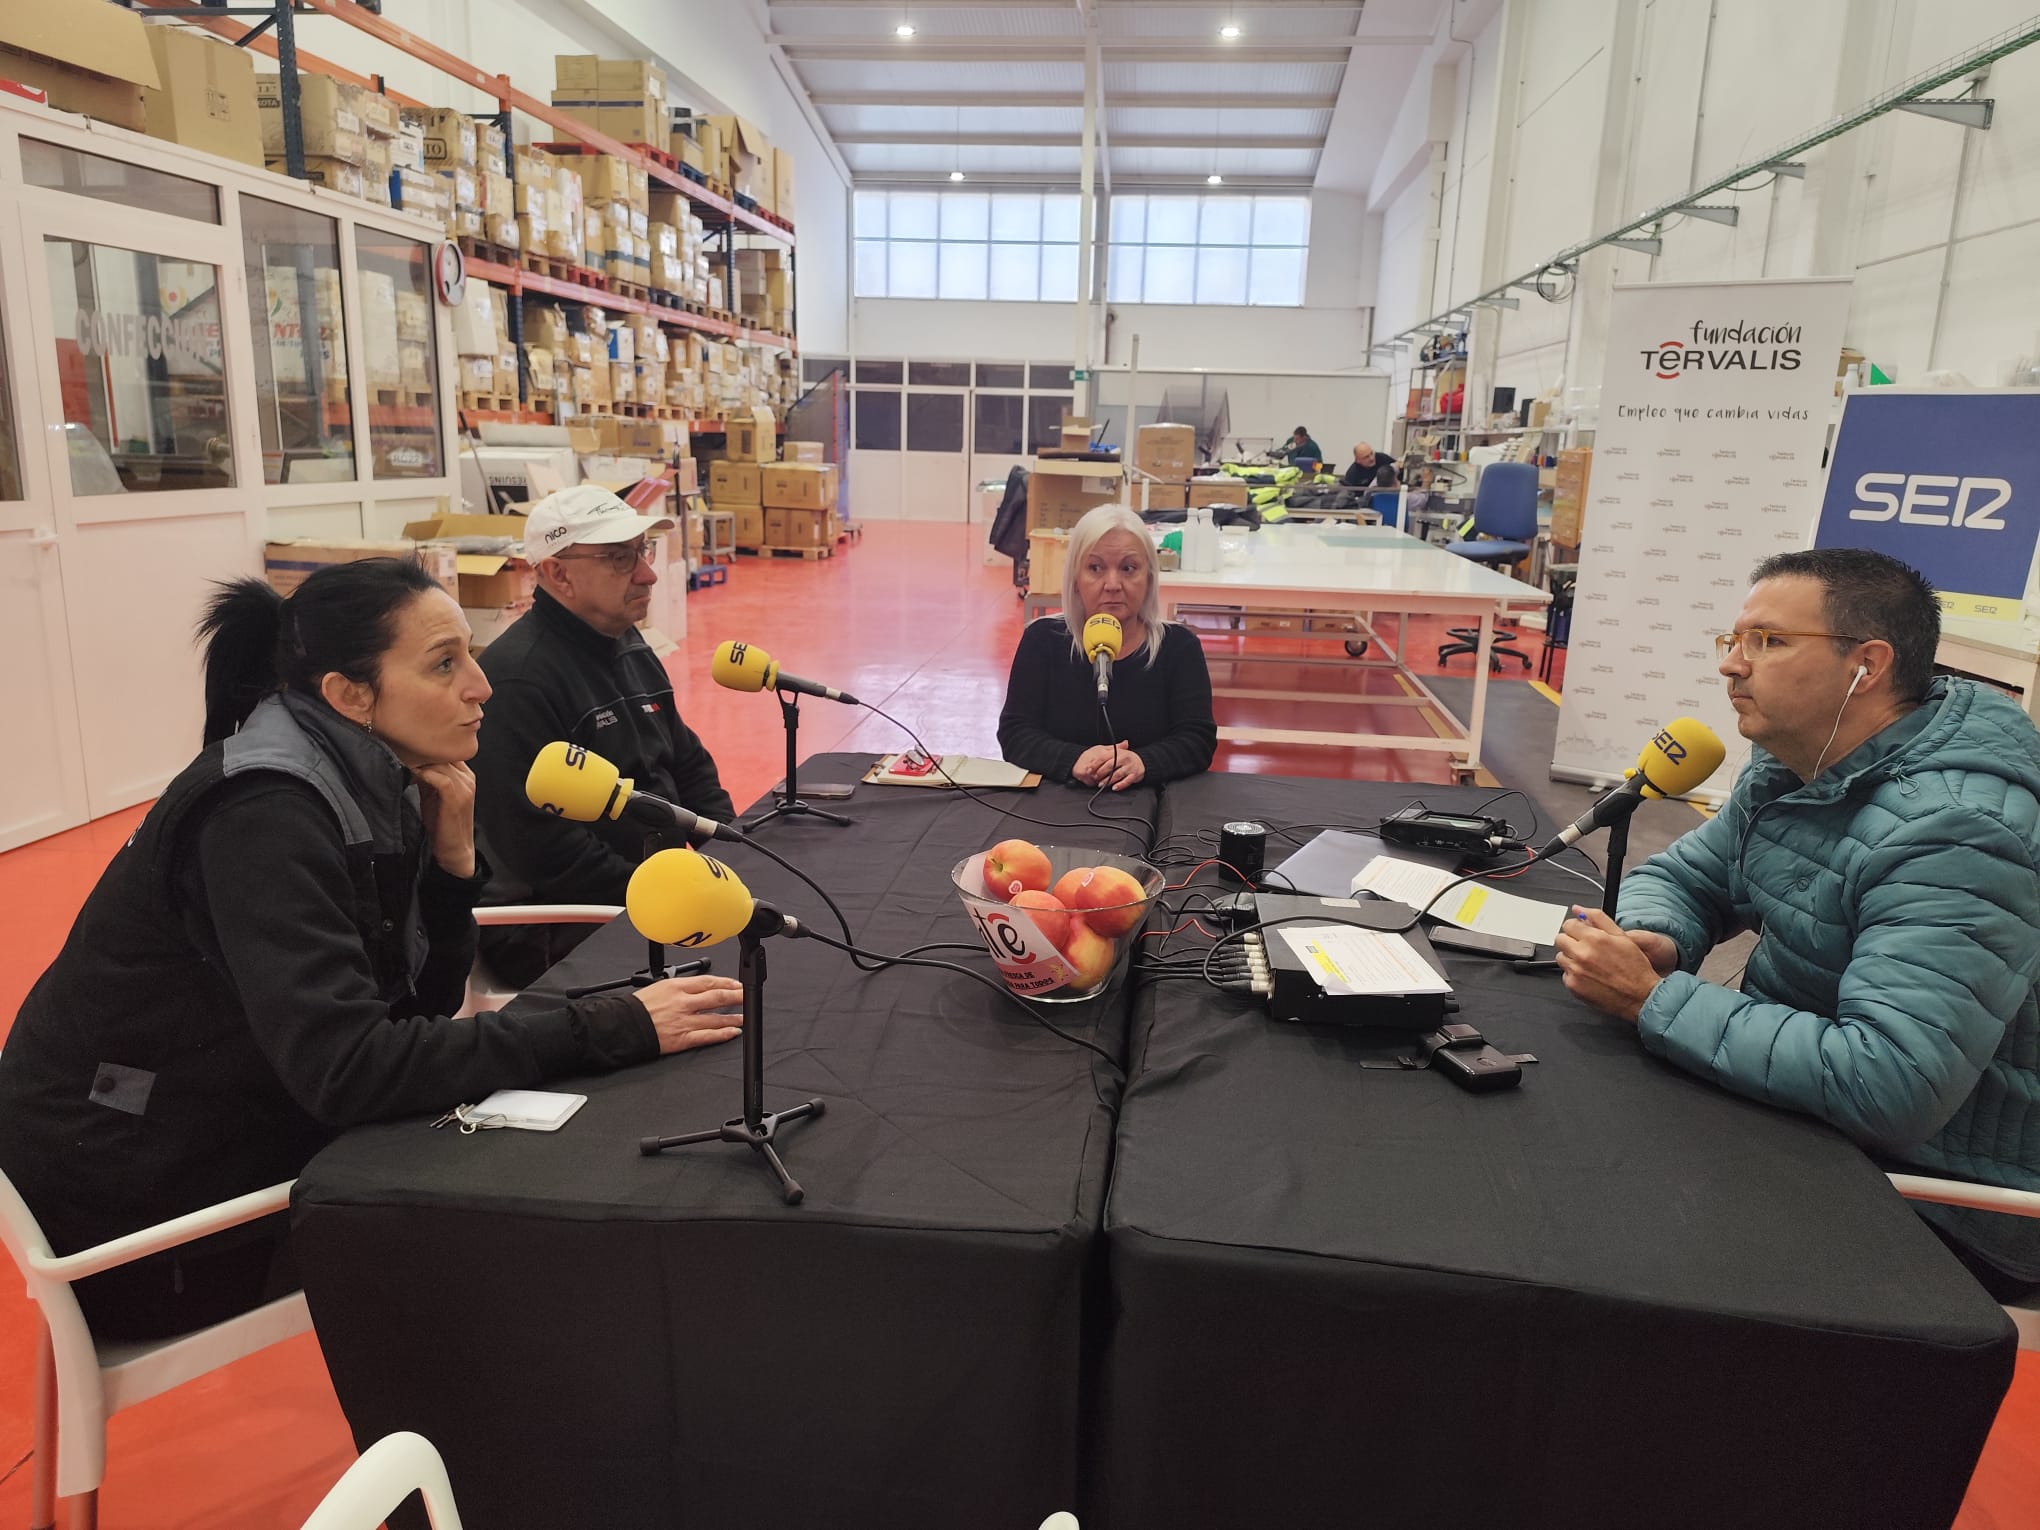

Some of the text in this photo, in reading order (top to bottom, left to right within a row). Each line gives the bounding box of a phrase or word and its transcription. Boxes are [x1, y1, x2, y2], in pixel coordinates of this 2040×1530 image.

[1690, 320, 1802, 344] fundación
[1618, 404, 1809, 423] Empleo que cambia vidas
[1849, 472, 2012, 531] SER
